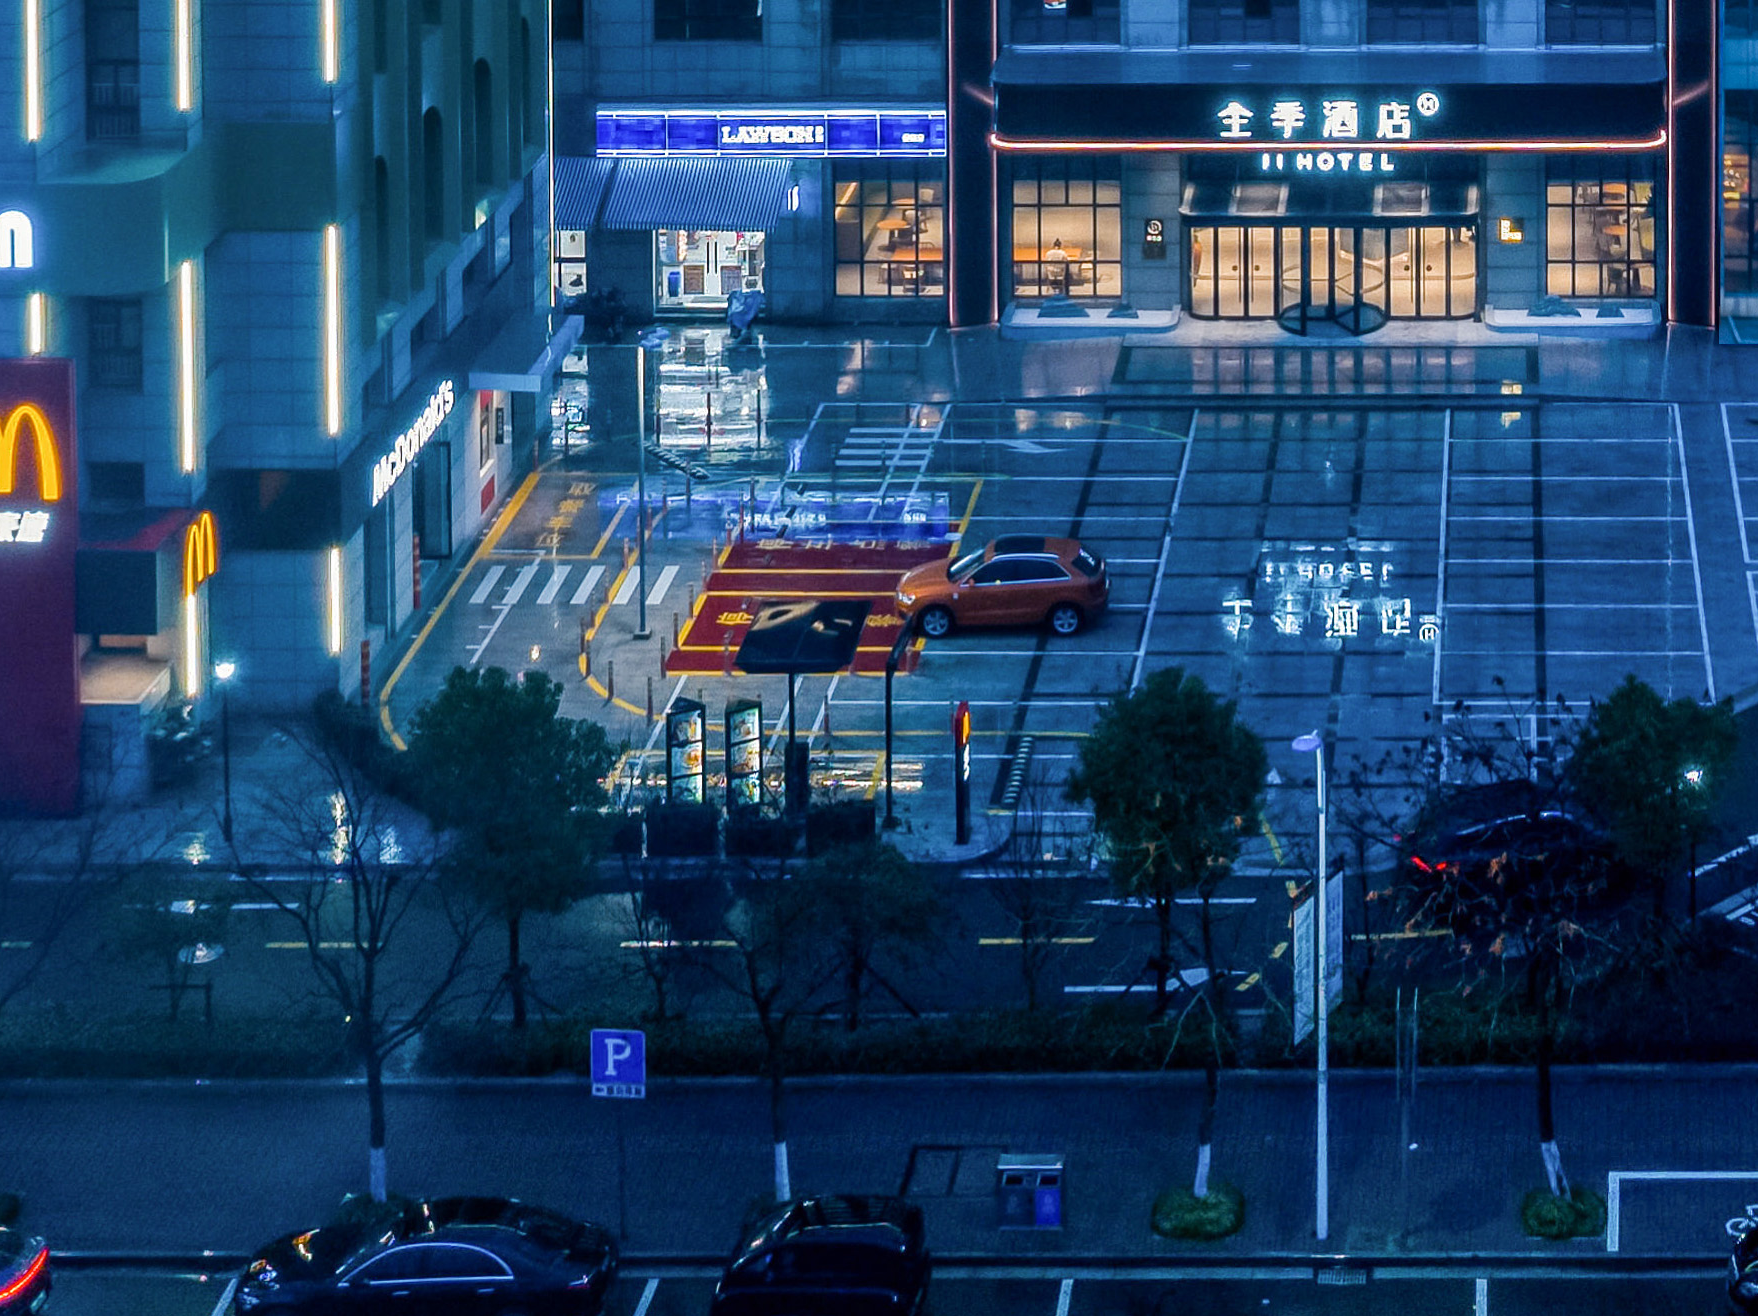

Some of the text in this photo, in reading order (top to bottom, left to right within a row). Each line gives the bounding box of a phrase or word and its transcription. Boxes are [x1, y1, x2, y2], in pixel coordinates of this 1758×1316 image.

[1217, 101, 1413, 140] 全季酒店
[1296, 152, 1395, 171] HOTEL
[605, 1038, 631, 1076] P
